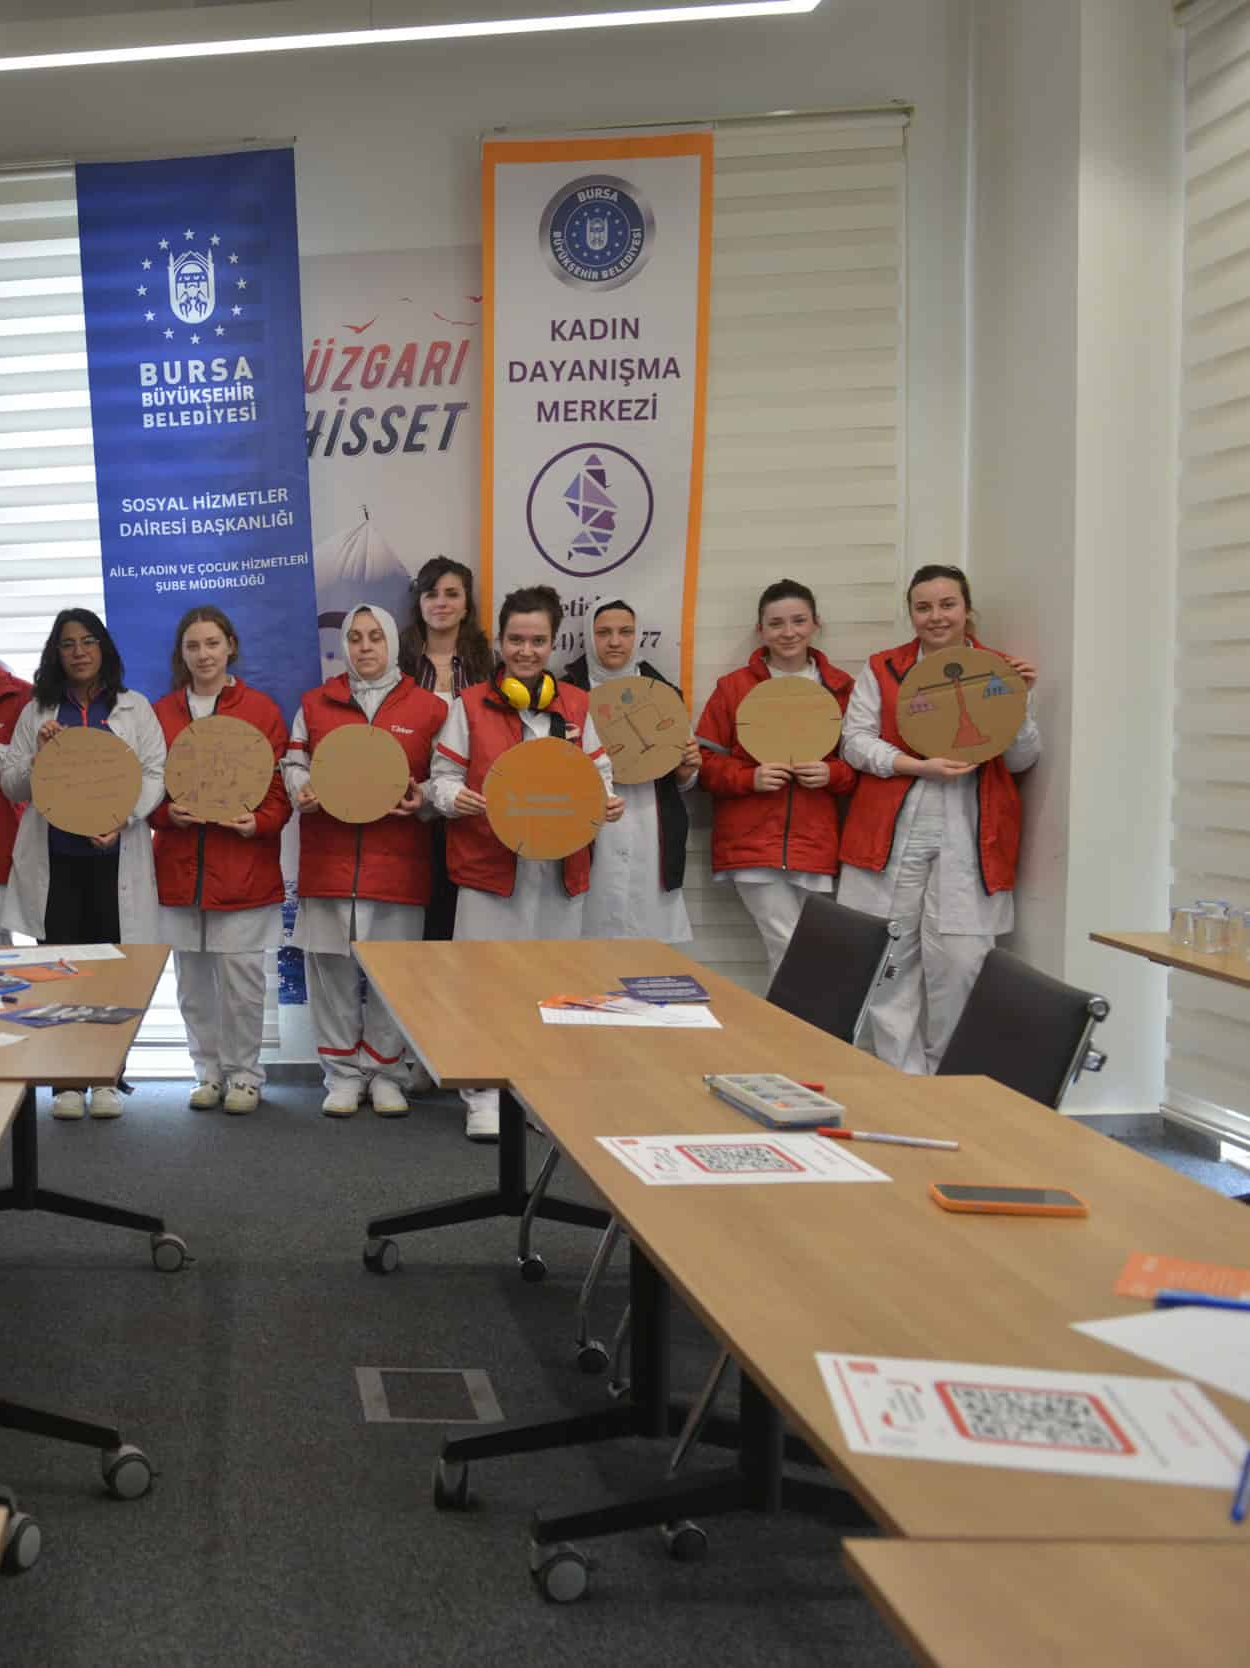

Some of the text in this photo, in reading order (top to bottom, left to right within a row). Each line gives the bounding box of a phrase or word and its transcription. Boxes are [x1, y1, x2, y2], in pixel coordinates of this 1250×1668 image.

[577, 187, 619, 203] BURSA
[550, 317, 639, 342] KADIN
[140, 356, 253, 387] BURSA
[508, 356, 681, 387] DAYANIŞMA
[141, 382, 255, 407] BÜYÜKŞEHİR
[142, 402, 257, 428] BELEDİYESİ
[536, 393, 658, 423] MERKEZİ
[122, 487, 289, 513] SOSYAL HİZMETLER
[119, 510, 294, 537] DAİRESİ BAŞKANLIĞI
[109, 552, 309, 578] AİLE, KADIN VE ÇOCUK HİZMETLERİ
[156, 575, 266, 594] ŞUBE MÜDÜRLÜĞÜ
